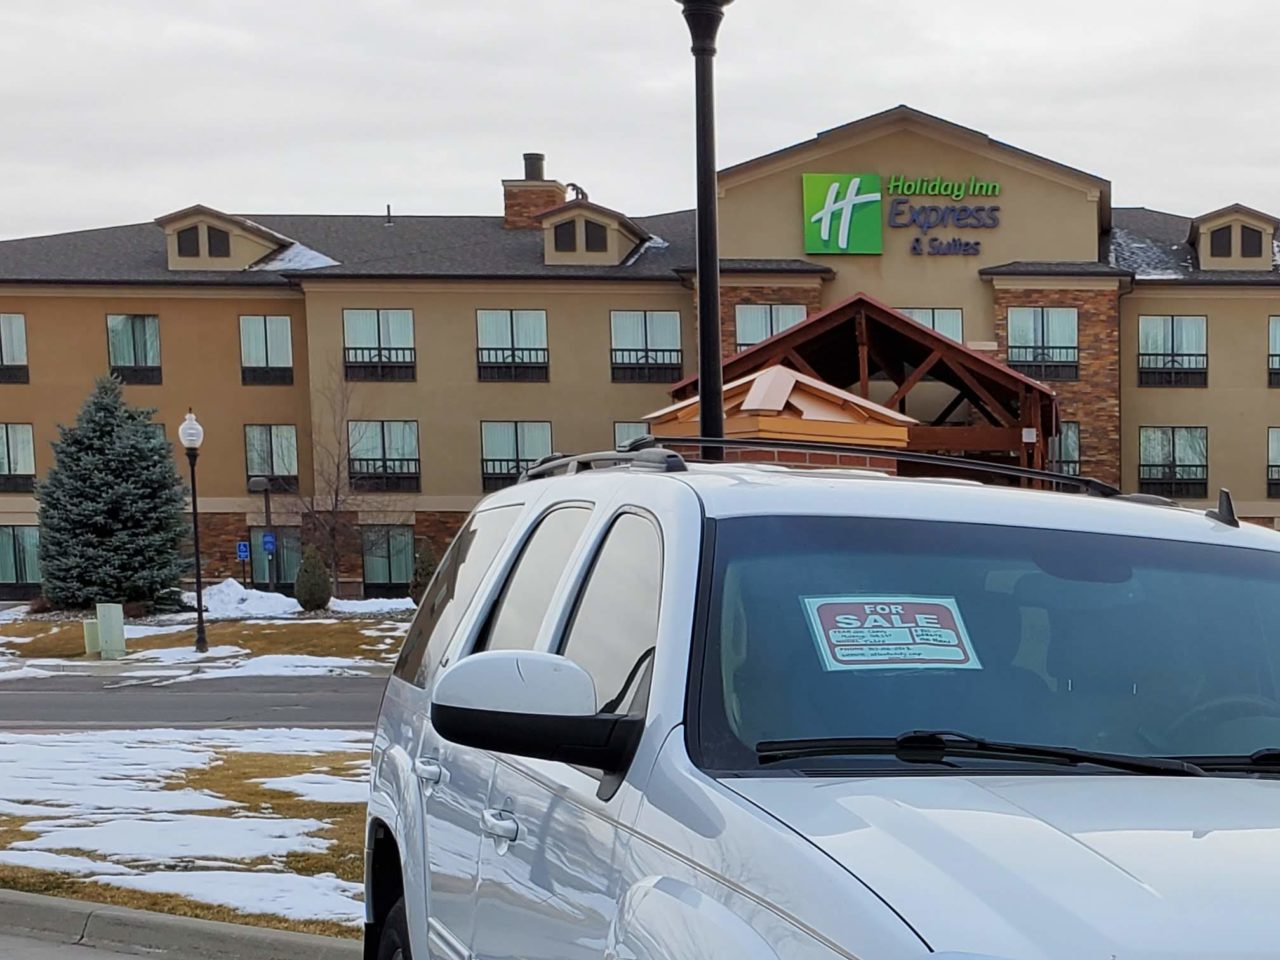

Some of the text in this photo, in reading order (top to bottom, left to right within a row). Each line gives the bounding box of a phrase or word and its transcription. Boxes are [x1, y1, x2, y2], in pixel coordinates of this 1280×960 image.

[887, 175, 1000, 201] Holiday Inn
[888, 198, 1000, 235] Express
[911, 237, 981, 255] & Suites
[864, 604, 904, 614] FOR
[834, 614, 941, 628] SALE
